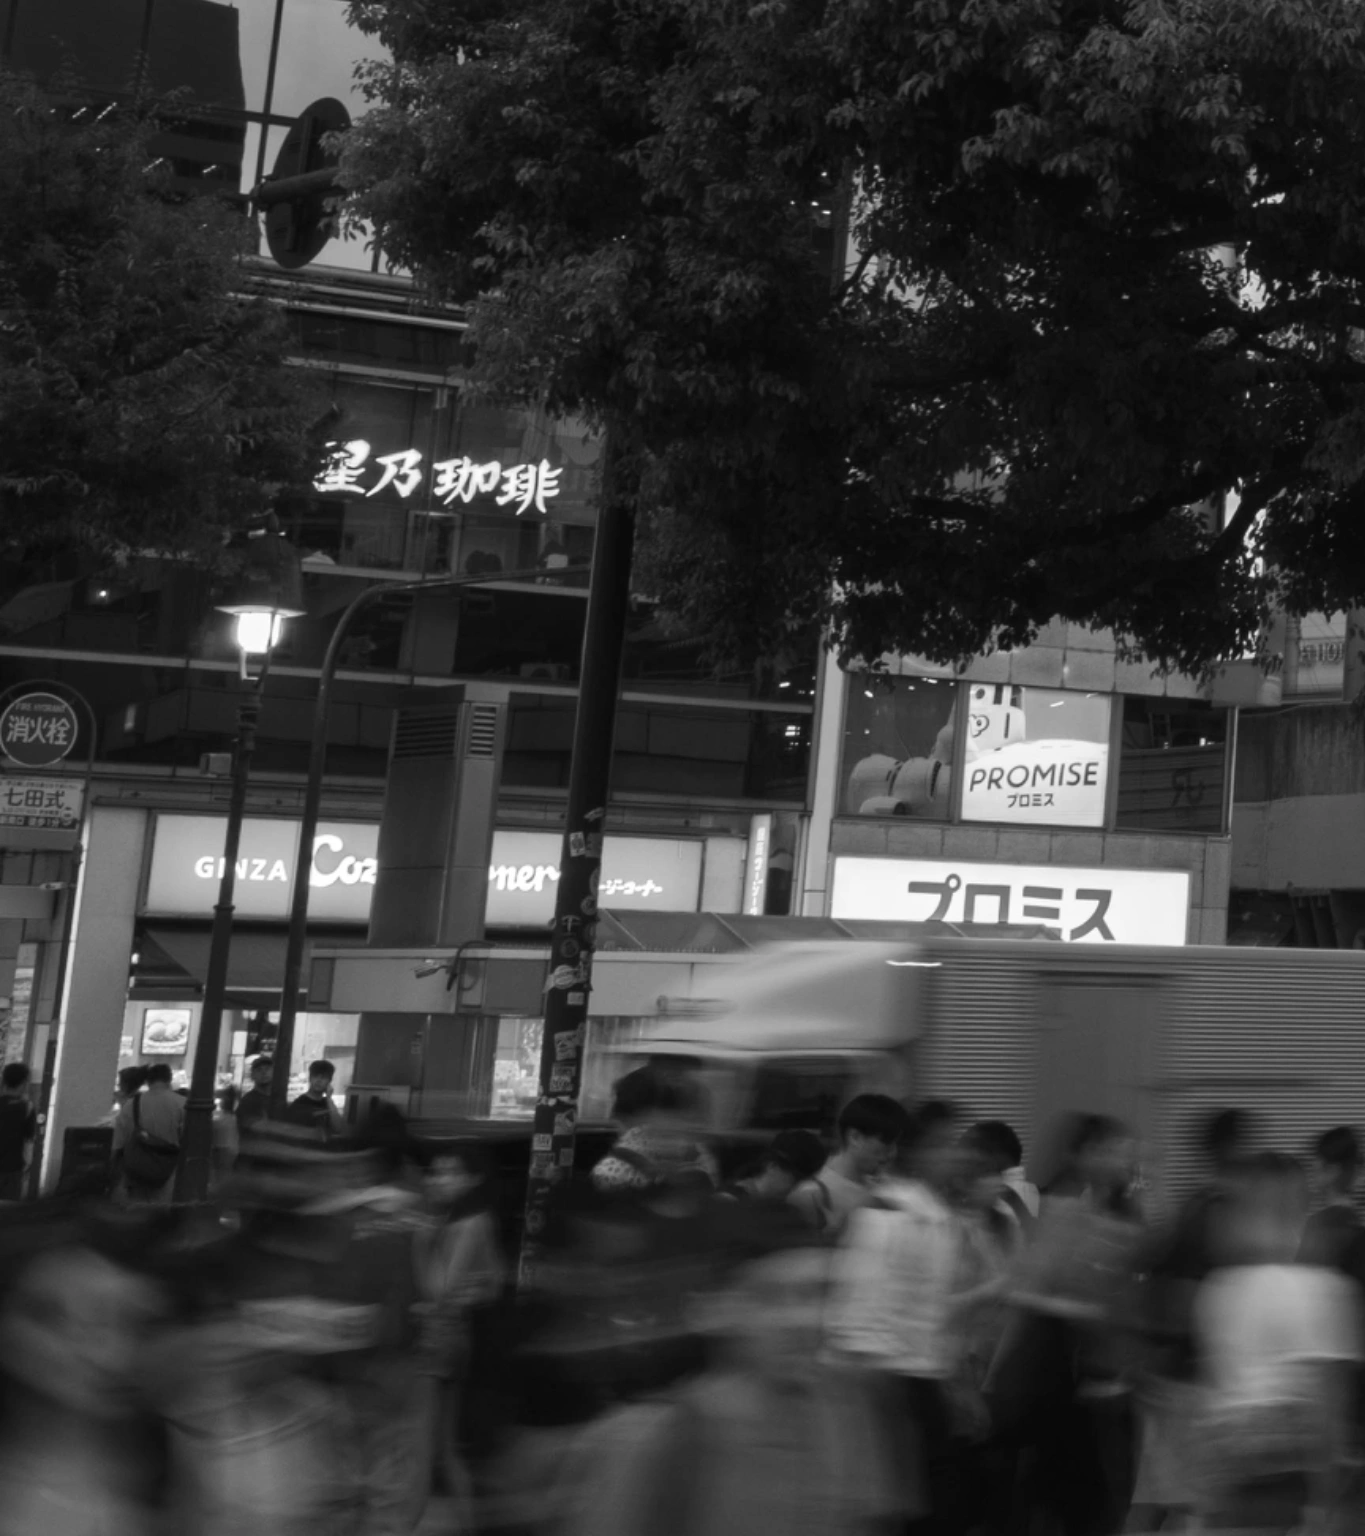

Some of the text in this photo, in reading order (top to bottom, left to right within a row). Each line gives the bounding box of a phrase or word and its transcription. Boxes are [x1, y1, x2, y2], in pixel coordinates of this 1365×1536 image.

[313, 439, 563, 516] 星乃珈琲
[6, 716, 70, 745] 消火栓
[969, 762, 1099, 792] PROMISE
[4, 788, 65, 809] 七田式
[1007, 793, 1054, 808] プロミス
[195, 856, 288, 882] GINZA
[309, 835, 378, 889] Coz
[907, 873, 1116, 942] プロミス
